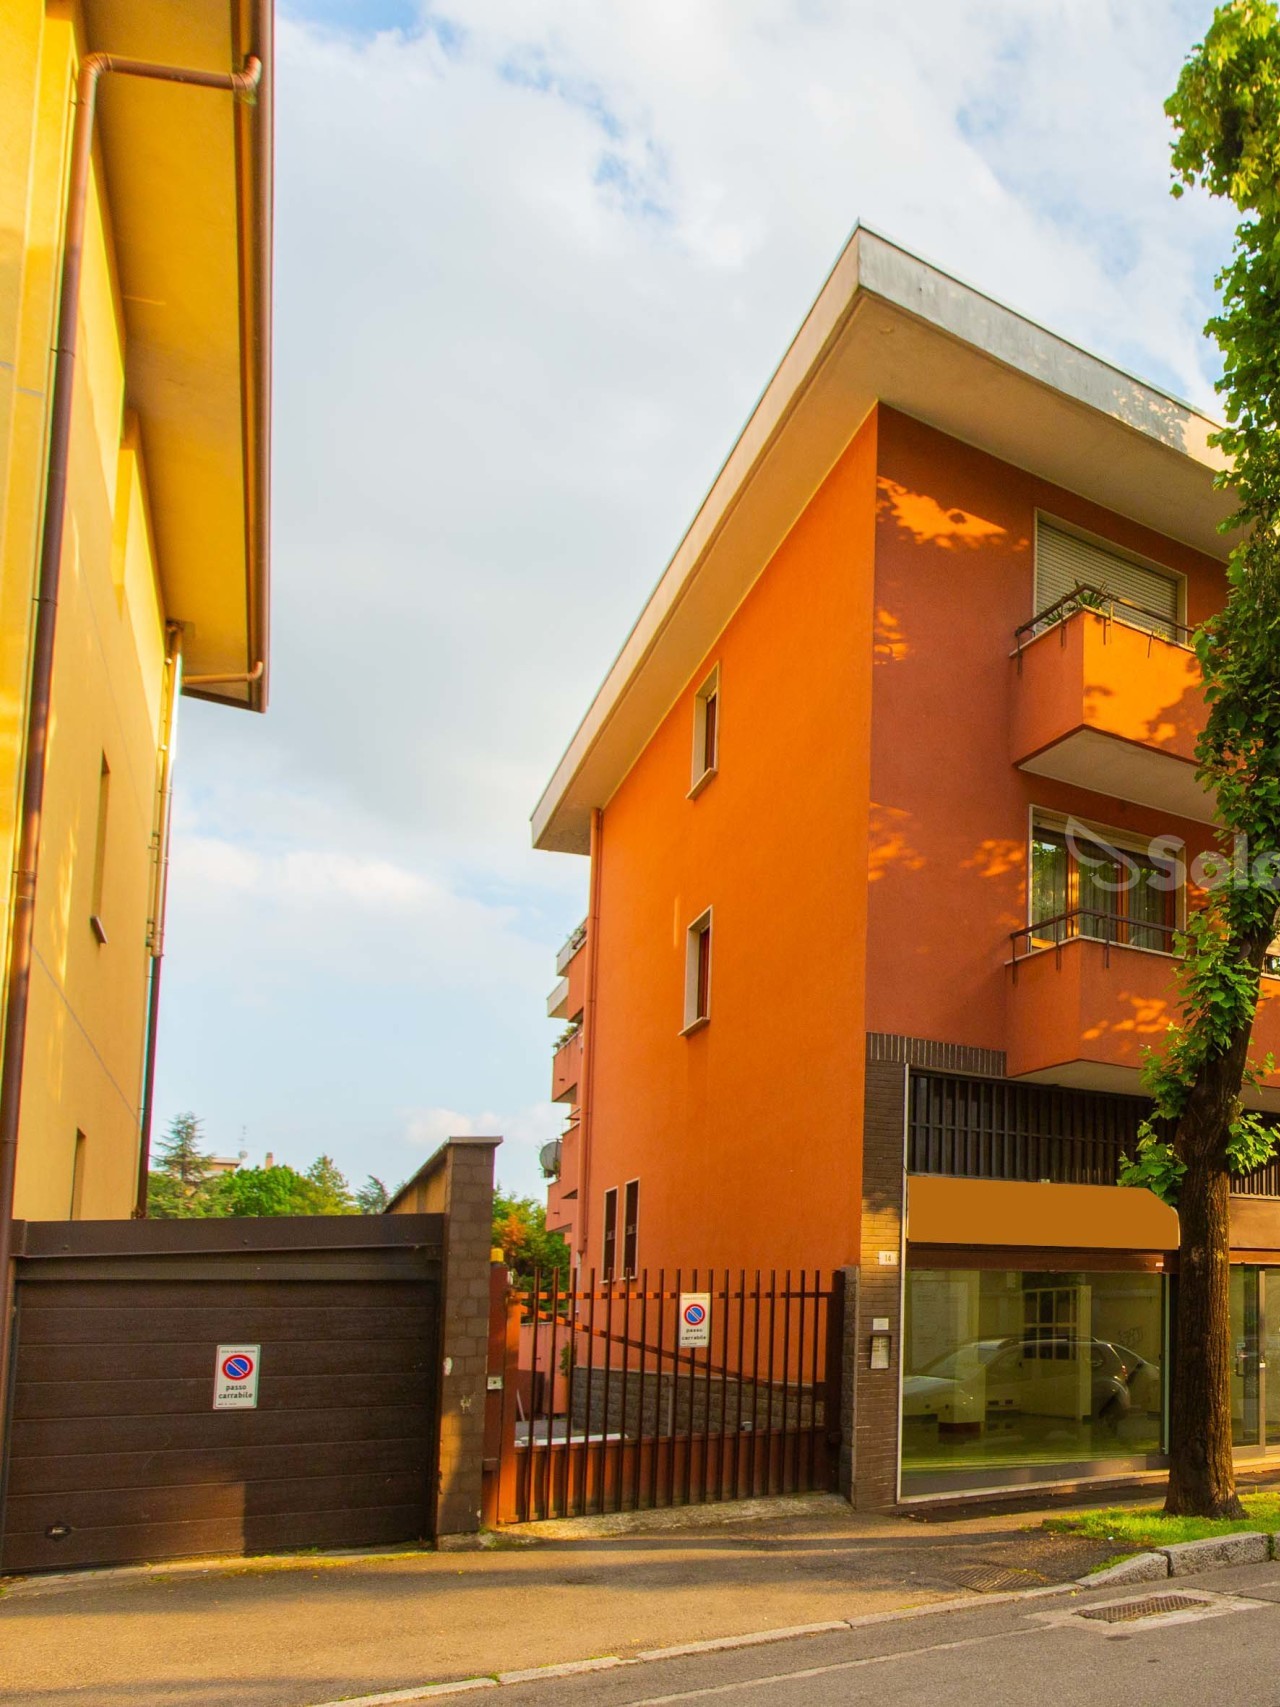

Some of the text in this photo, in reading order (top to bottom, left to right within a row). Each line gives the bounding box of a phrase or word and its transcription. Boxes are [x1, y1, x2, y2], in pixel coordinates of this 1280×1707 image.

[885, 1253, 892, 1263] 14
[225, 1384, 248, 1392] passo
[218, 1391, 253, 1399] carrabile
